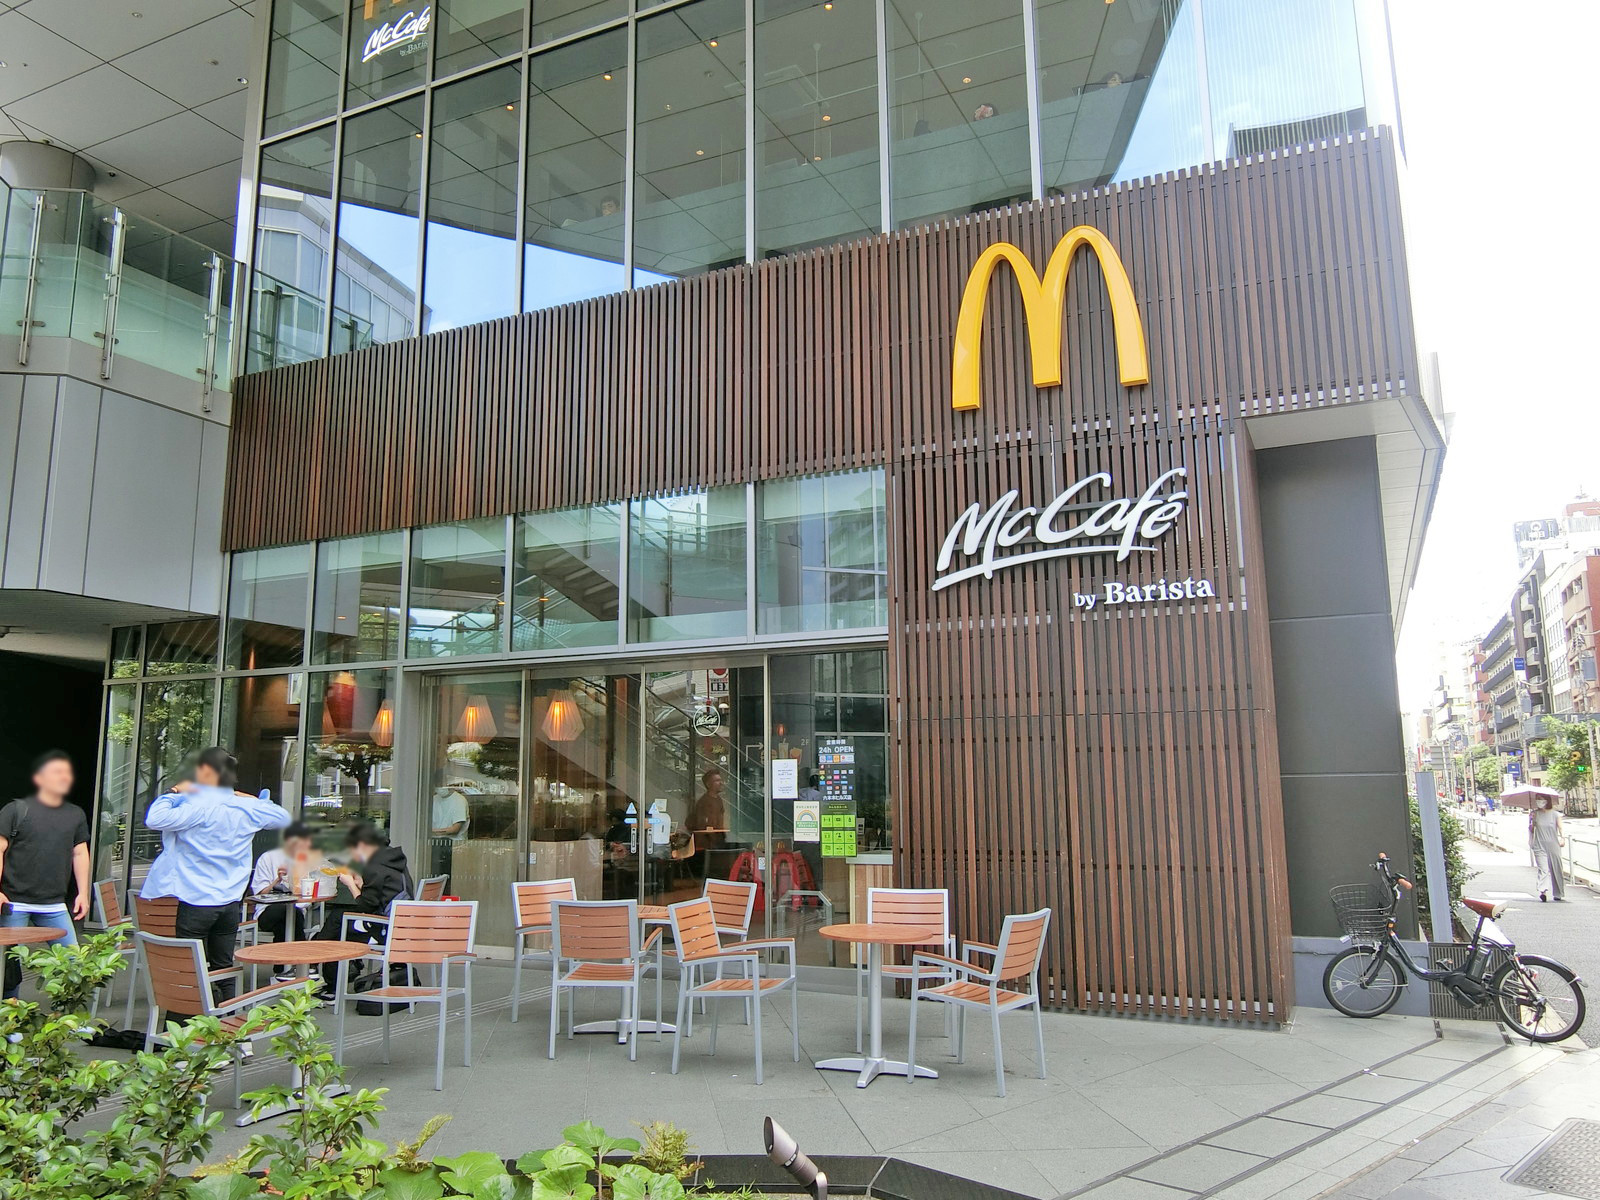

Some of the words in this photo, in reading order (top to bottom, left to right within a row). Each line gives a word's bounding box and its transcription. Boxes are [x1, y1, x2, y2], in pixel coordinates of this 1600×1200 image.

[932, 467, 1188, 591] McCafé
[1073, 591, 1097, 610] by
[1103, 577, 1216, 605] Barista
